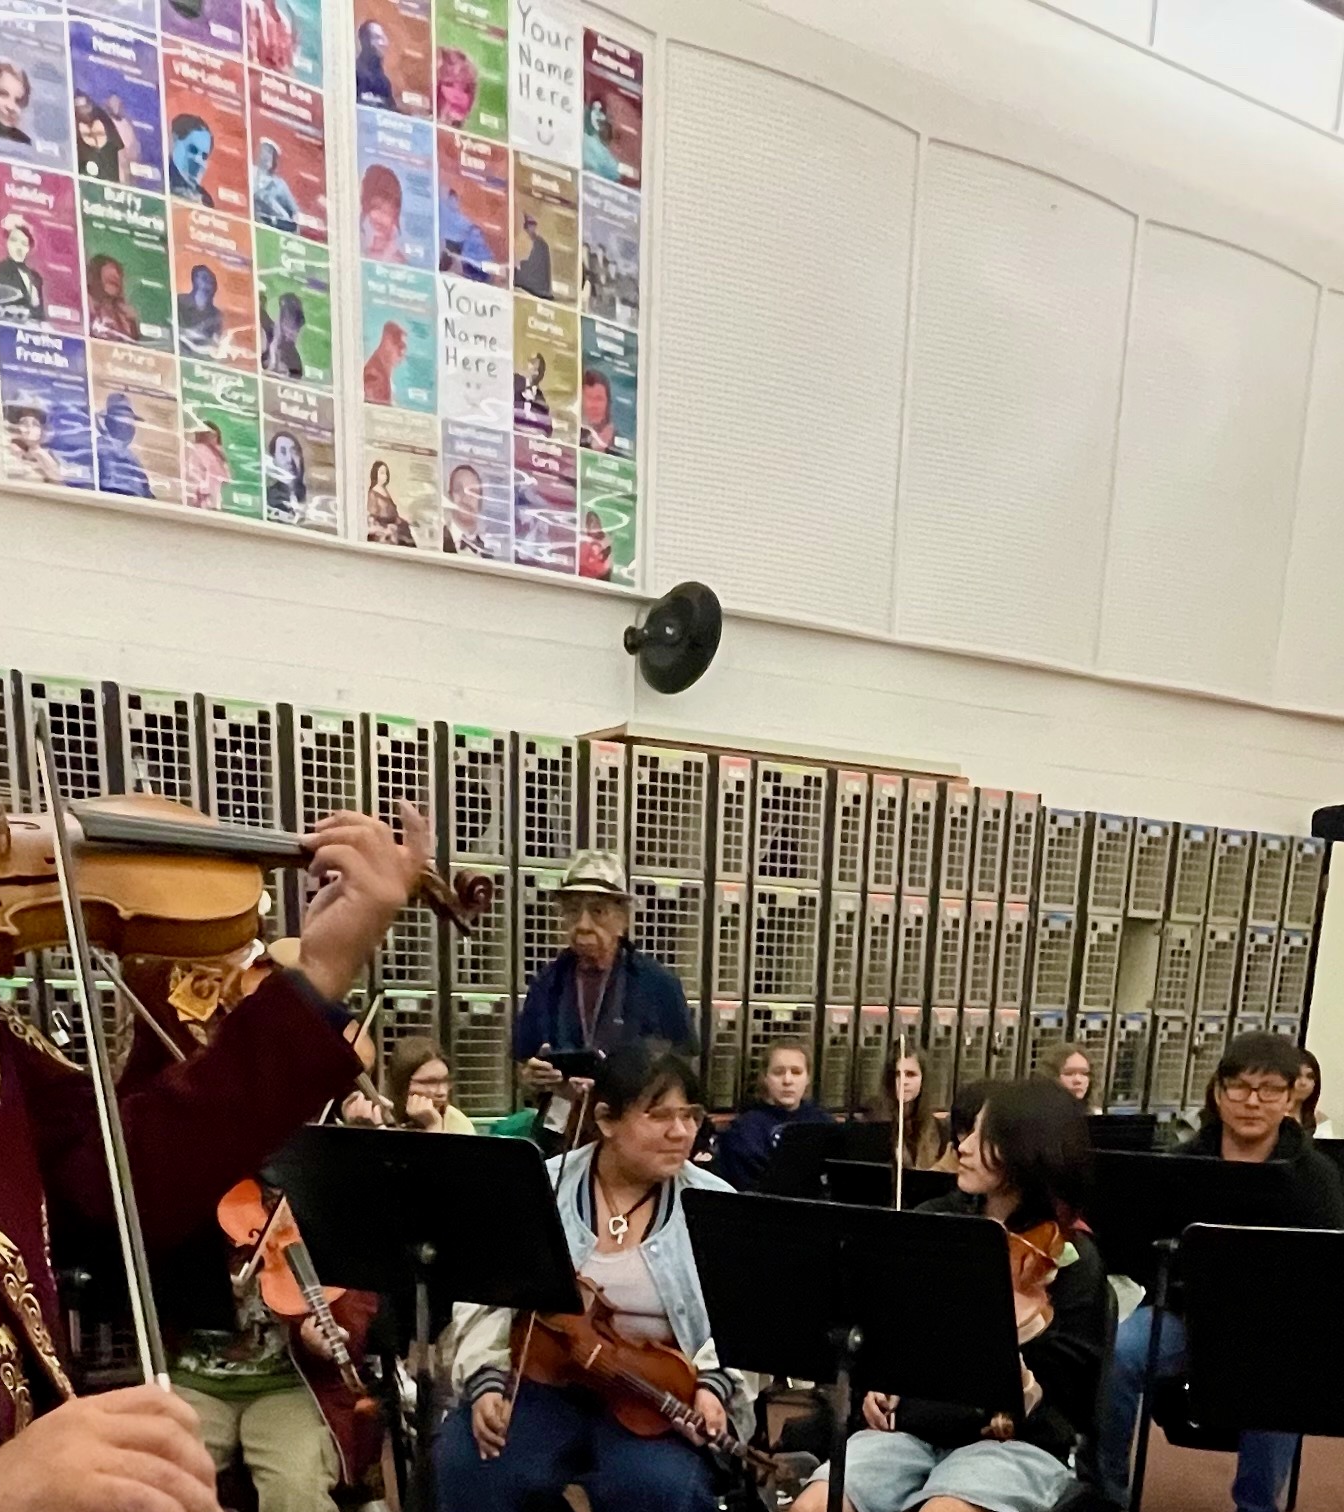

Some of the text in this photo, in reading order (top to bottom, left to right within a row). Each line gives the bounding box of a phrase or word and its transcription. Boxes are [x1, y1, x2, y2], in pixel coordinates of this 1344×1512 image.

[517, 0, 574, 51] Your
[518, 42, 574, 86] Name
[519, 73, 573, 114] Here
[443, 279, 501, 318] Your
[444, 317, 498, 352] Name
[16, 347, 69, 368] Franklin
[446, 346, 498, 378] Here
